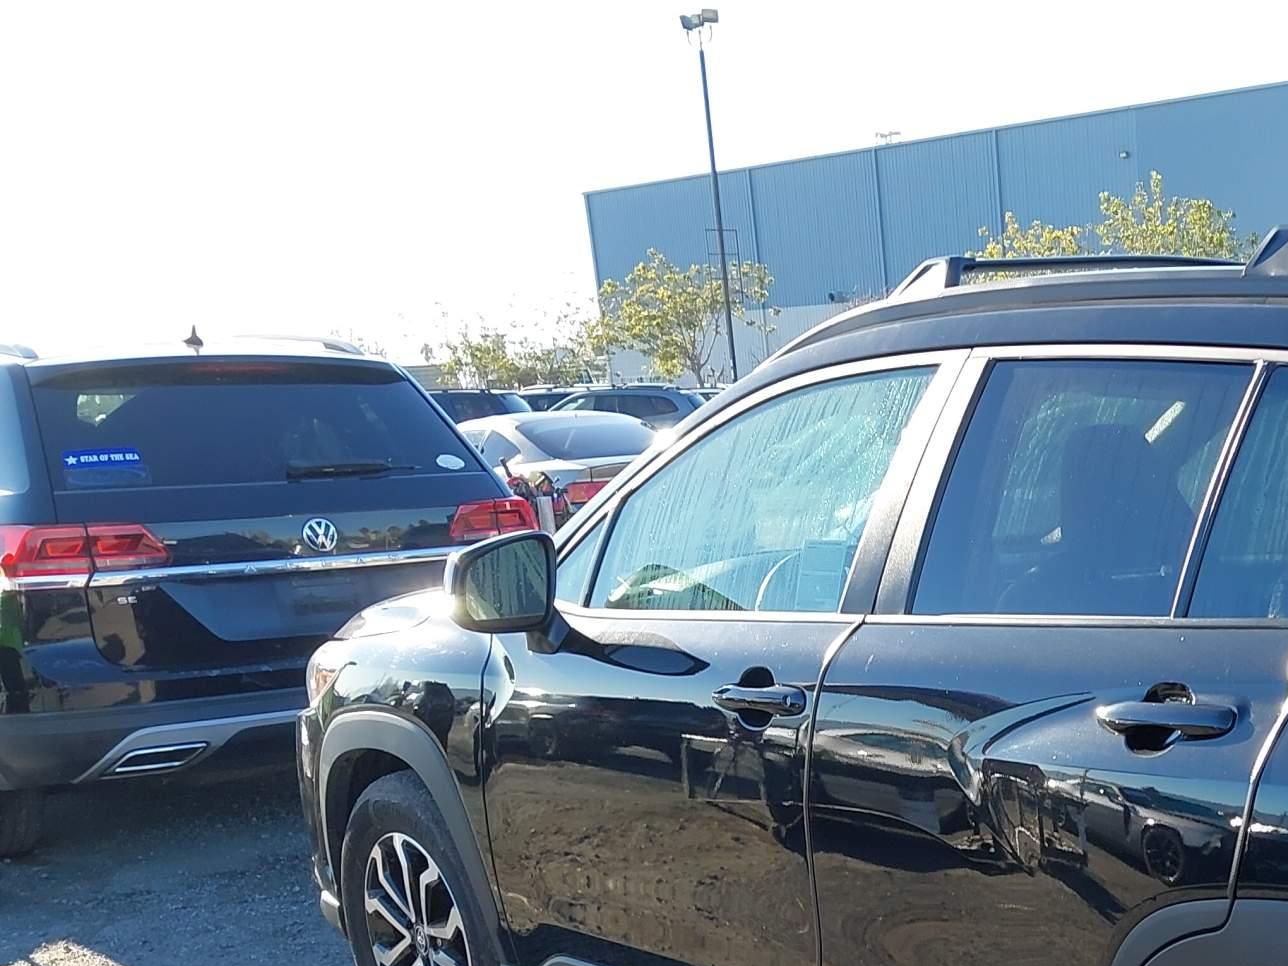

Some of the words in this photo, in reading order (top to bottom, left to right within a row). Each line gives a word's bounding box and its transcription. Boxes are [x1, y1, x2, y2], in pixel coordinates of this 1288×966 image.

[80, 454, 99, 463] STAR
[99, 454, 109, 462] OF
[110, 453, 124, 461] THE
[125, 453, 139, 461] SEA
[117, 595, 138, 605] SE
